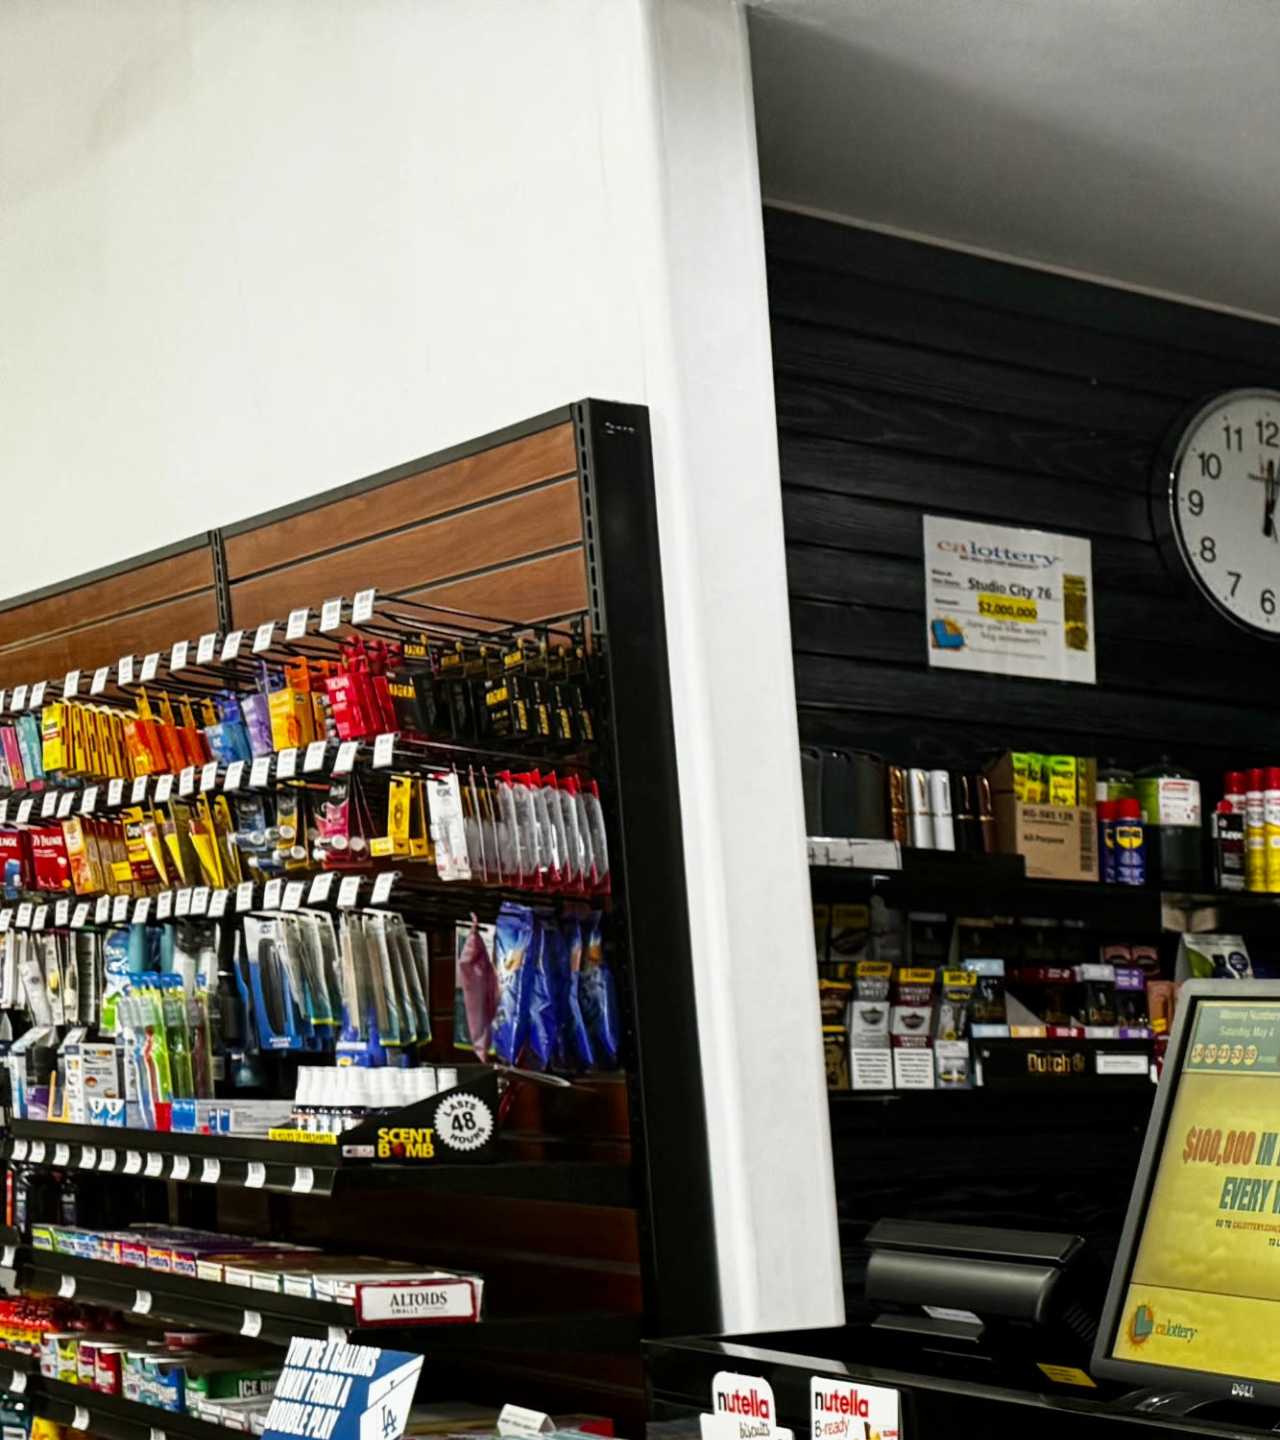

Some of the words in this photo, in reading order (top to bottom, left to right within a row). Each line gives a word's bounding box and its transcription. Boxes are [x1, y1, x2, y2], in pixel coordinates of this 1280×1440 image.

[1223, 426, 1243, 452] 11
[1256, 420, 1279, 447] 12
[1199, 454, 1221, 480] 10
[1188, 491, 1204, 515] 9
[937, 537, 1057, 567] calottery
[1200, 538, 1216, 562] 8
[967, 578, 1007, 596] Studio
[1009, 583, 1035, 599] City
[1036, 586, 1052, 599] 76
[1226, 572, 1241, 598] 7
[1260, 590, 1275, 614] 6
[442, 1098, 478, 1125] LASTS
[451, 1109, 477, 1134] 48
[378, 1128, 434, 1143] SCENT
[1184, 1126, 1256, 1166] $100,000
[1256, 1132, 1278, 1166] IN
[1219, 1176, 1276, 1212] EVERY
[389, 1290, 449, 1307] ALTOIDS
[718, 1390, 770, 1419] nutella
[815, 1389, 869, 1418] nutella
